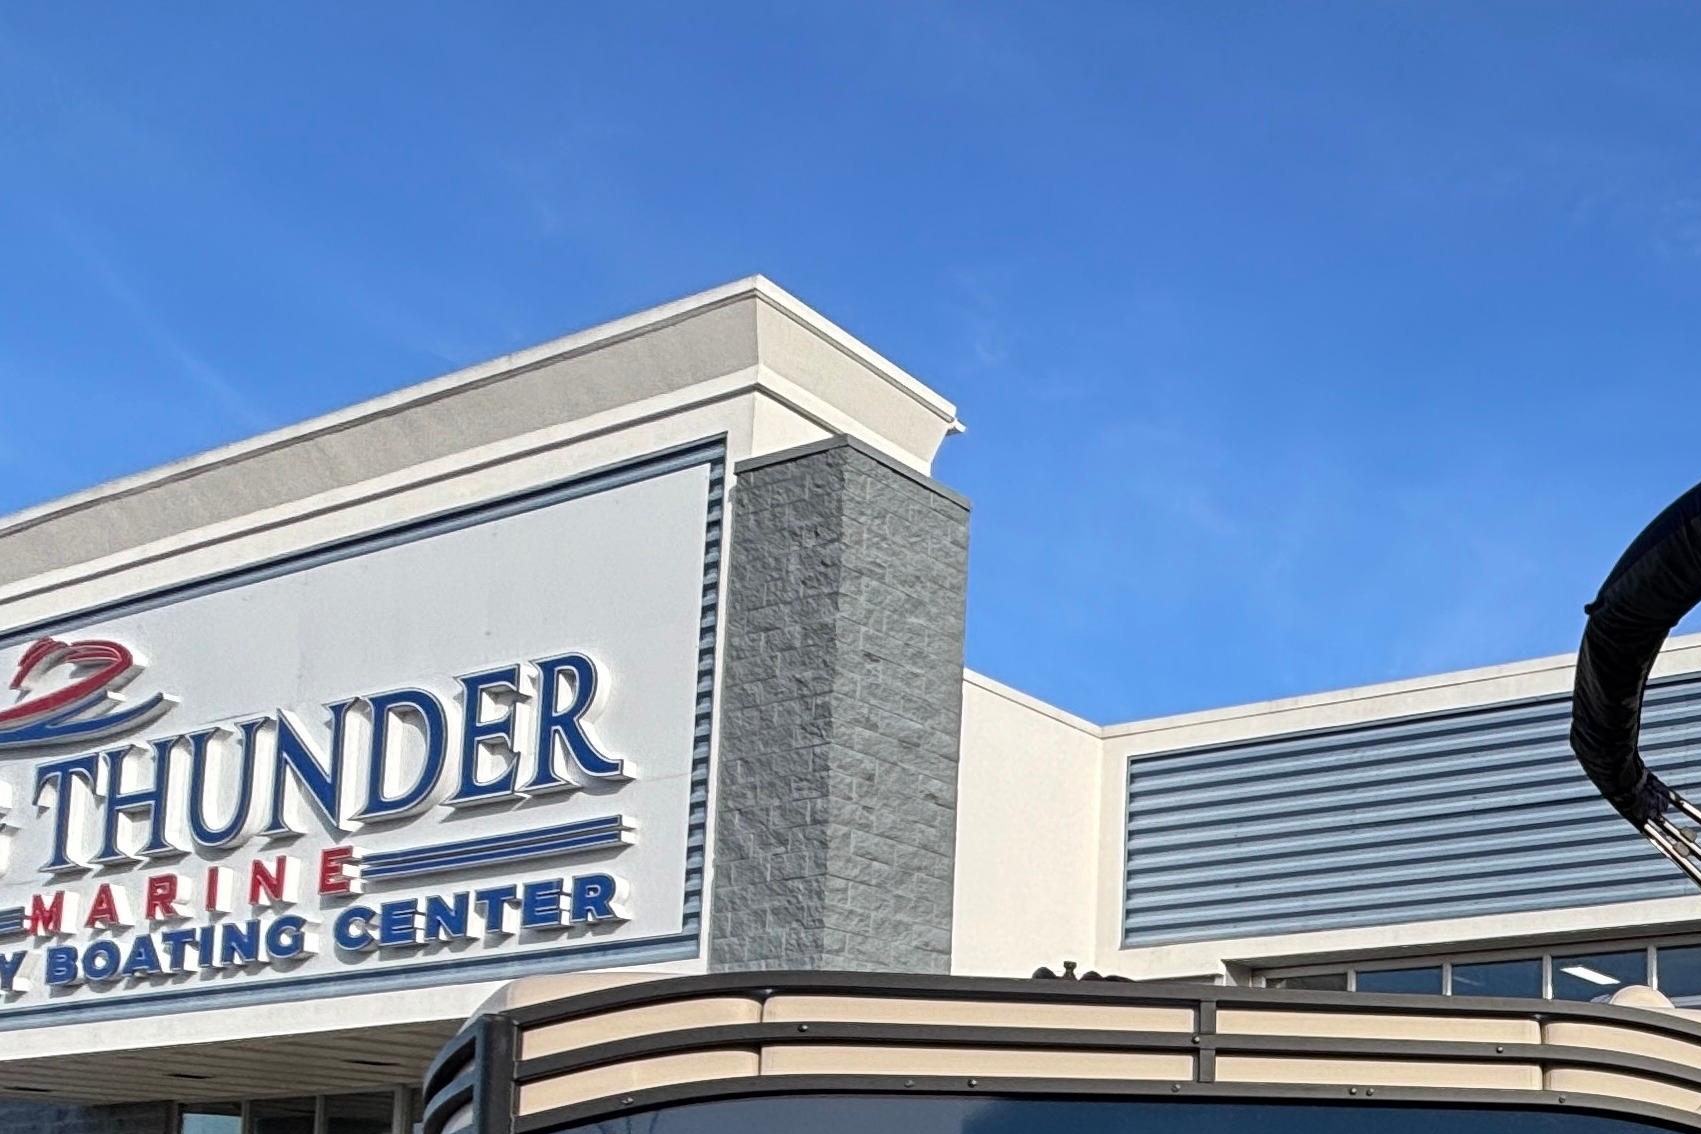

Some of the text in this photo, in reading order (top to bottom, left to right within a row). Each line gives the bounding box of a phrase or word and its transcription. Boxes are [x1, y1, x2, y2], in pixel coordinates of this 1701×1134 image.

[32, 651, 625, 873] THUNDER
[27, 846, 354, 937] MARINE
[45, 914, 304, 986] BOATING
[334, 872, 617, 951] CENTER
